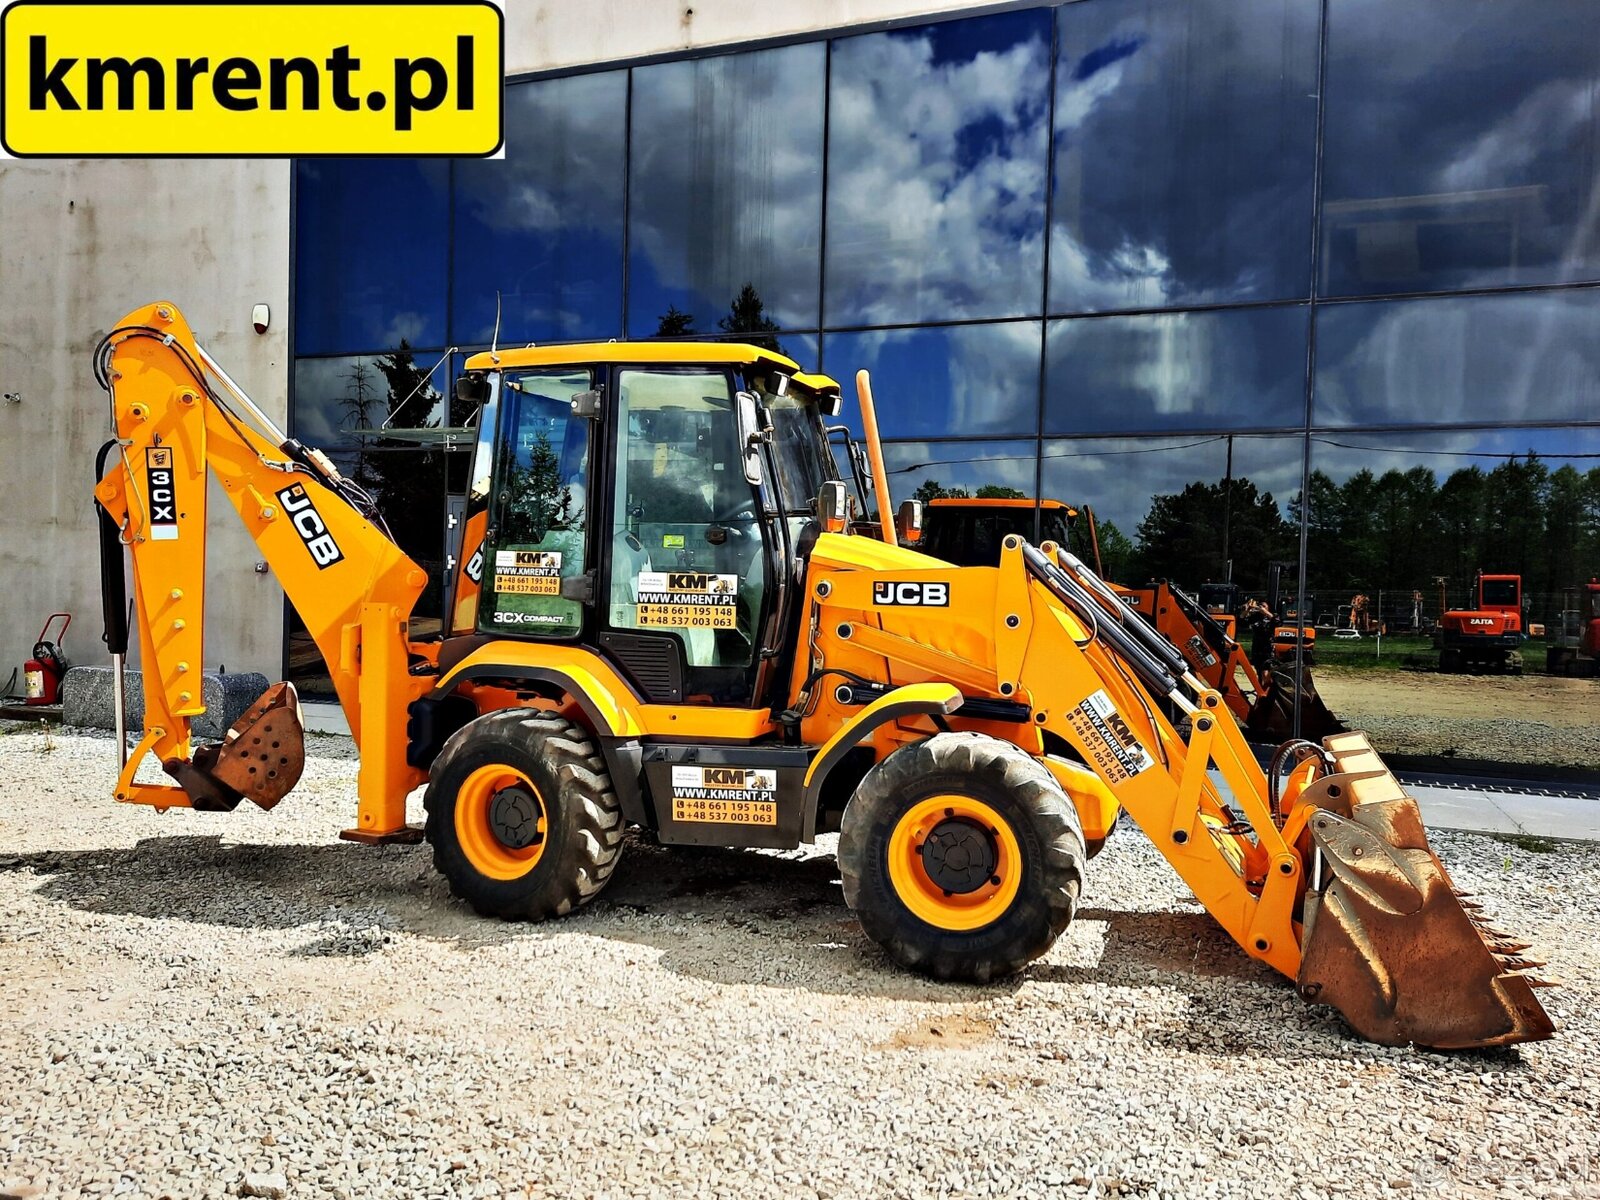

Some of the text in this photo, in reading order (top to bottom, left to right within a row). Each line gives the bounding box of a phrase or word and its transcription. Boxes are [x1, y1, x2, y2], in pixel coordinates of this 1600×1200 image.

[152, 471, 173, 520] 3CX
[279, 490, 340, 566] JCB
[516, 552, 541, 563] KM
[496, 567, 559, 576] WWW.KMRENT.PL
[669, 574, 707, 589] KM
[638, 593, 736, 605] WWW.KMRENT.PL
[875, 583, 947, 605] JCB
[493, 612, 524, 623] 3CX
[524, 615, 564, 623] COMPACT
[650, 606, 732, 616] +48 661 195 148
[650, 616, 732, 626] +48 537 003 063
[1106, 712, 1137, 747] KM
[1080, 700, 1136, 777] WWW.KMRENT.PL
[1072, 721, 1119, 784] +48 537 003 063
[1079, 716, 1092, 731] +48
[1090, 732, 1104, 746] 661
[1102, 748, 1115, 762] 195
[1113, 763, 1127, 779] 148
[704, 769, 744, 785] KM
[674, 787, 775, 801] WWW.KMRENT.PL
[687, 801, 772, 812] +48 661 195 148
[687, 811, 772, 823] +48 537 003 063
